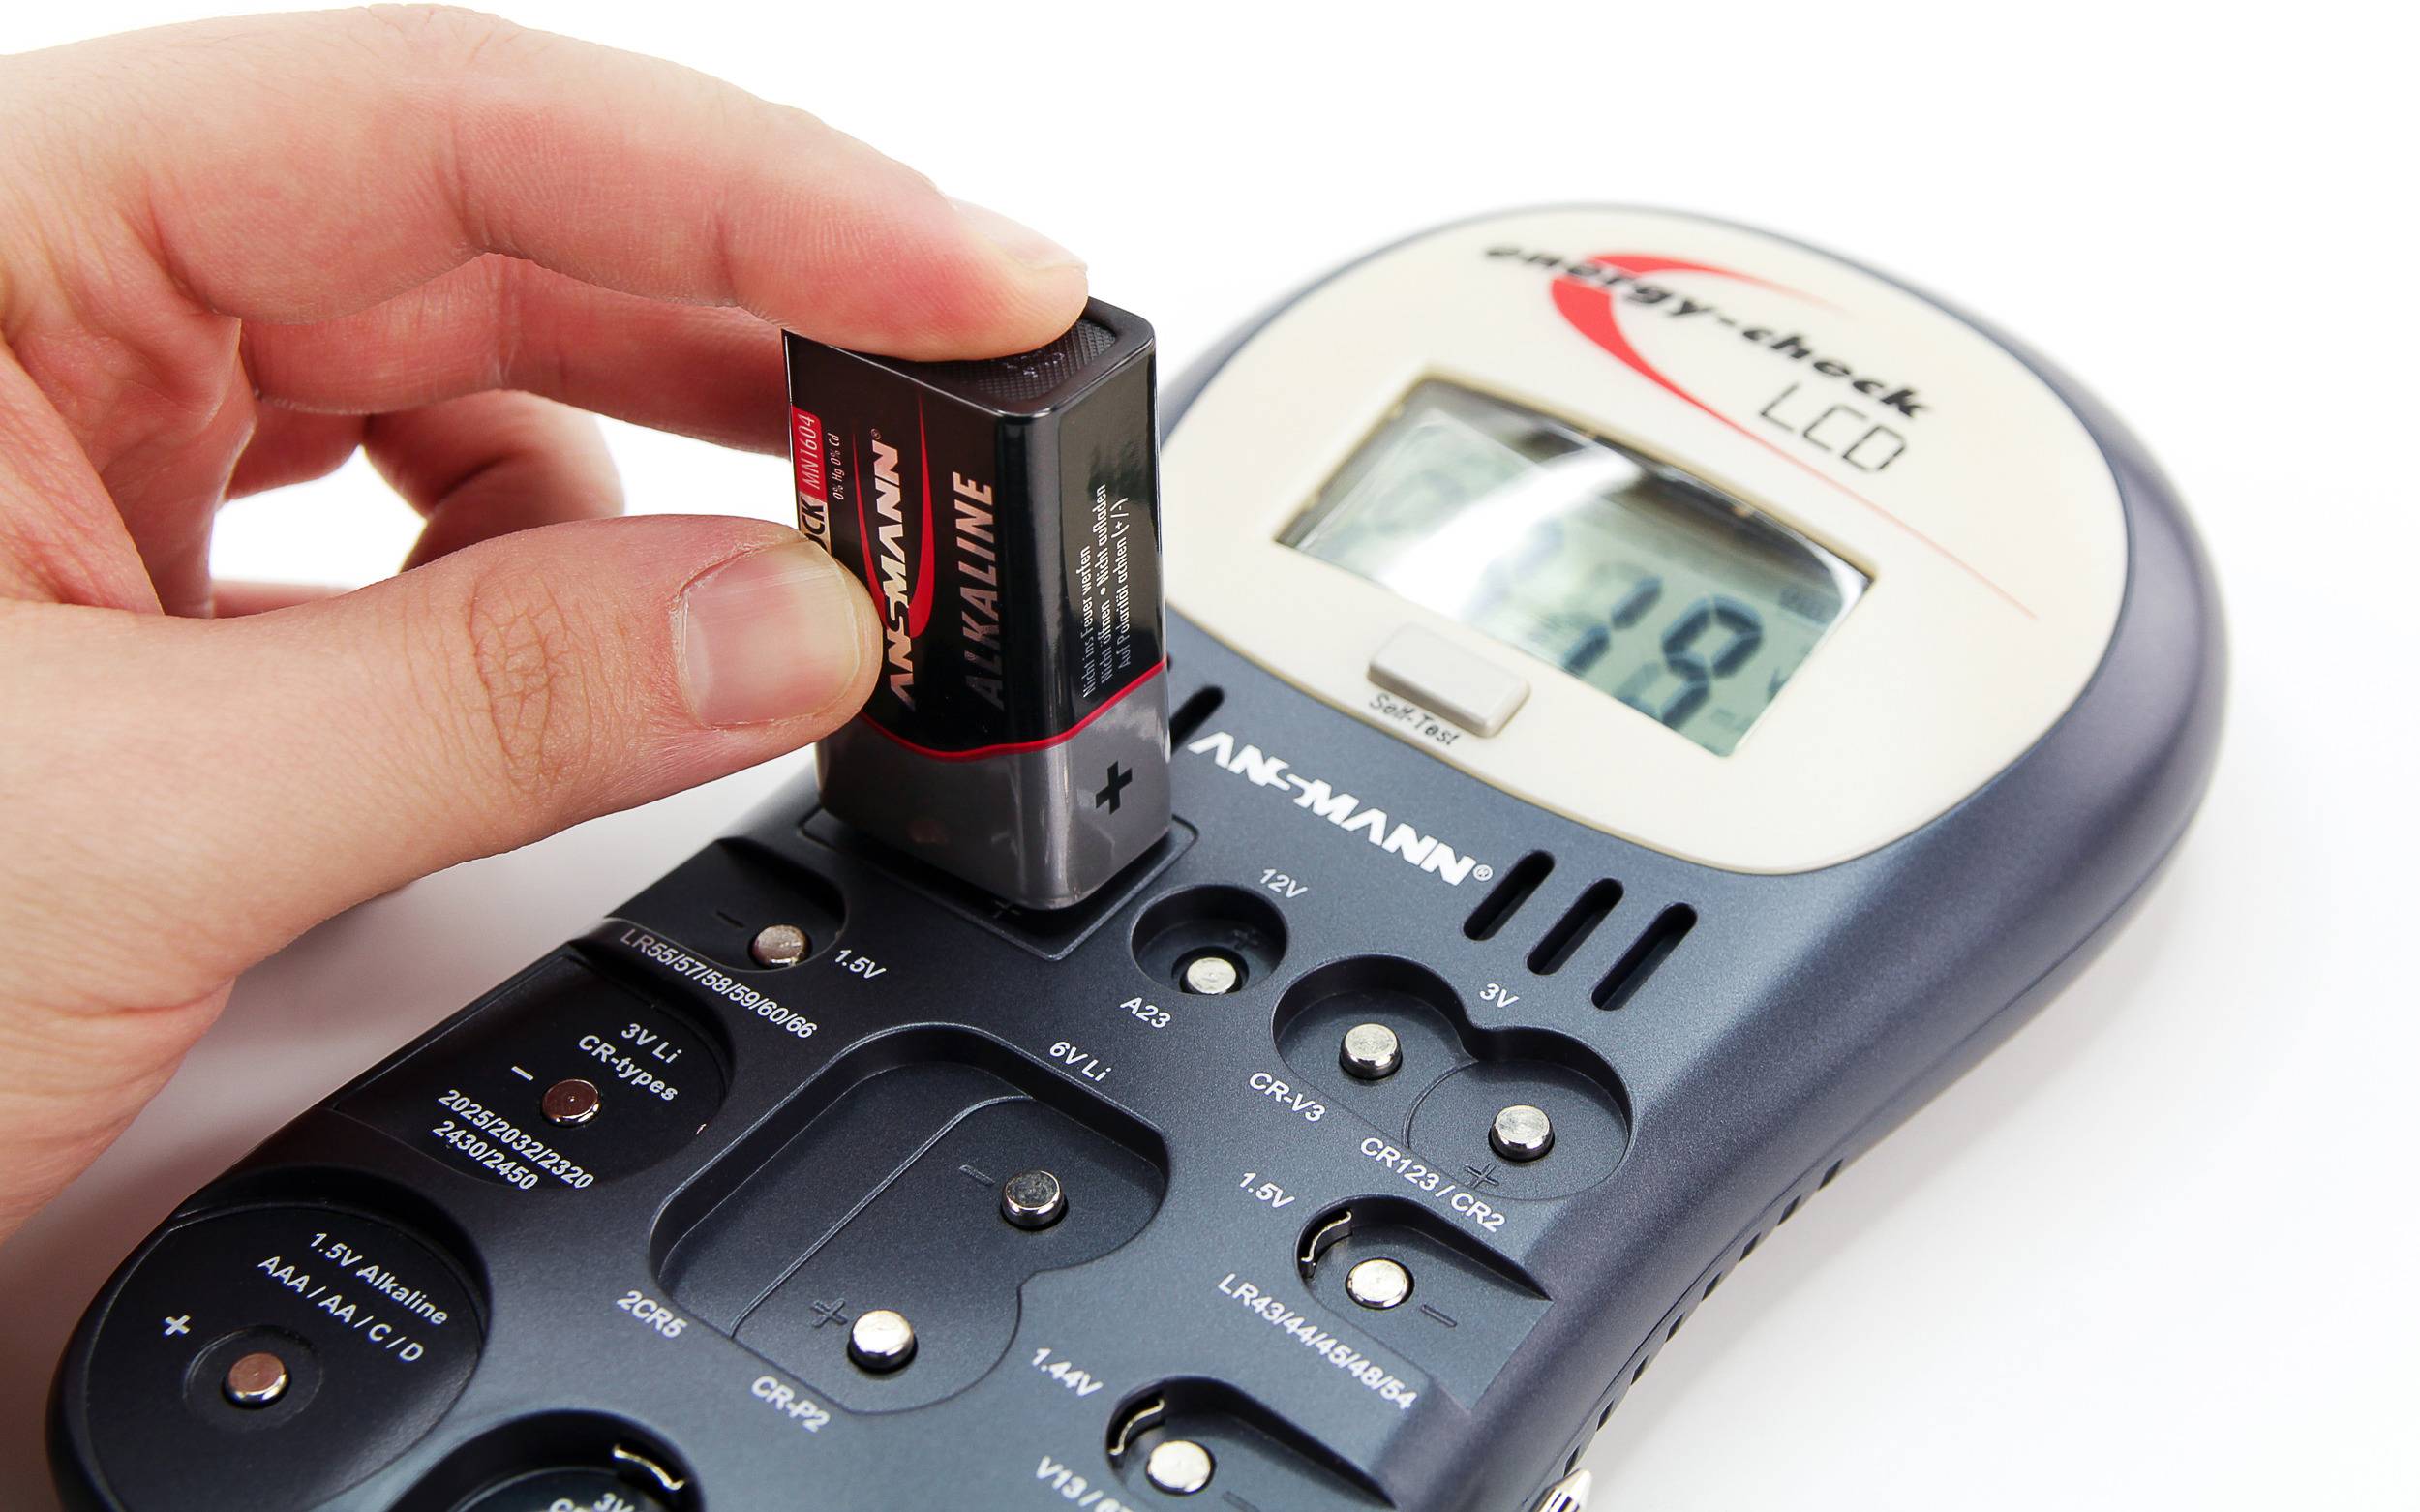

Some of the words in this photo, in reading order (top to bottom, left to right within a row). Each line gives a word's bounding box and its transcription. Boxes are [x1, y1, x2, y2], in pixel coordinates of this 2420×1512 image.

[1484, 246, 1934, 419] energy-check
[826, 432, 841, 447] Cd
[1759, 381, 1907, 473] LCD
[797, 413, 821, 491] MN1604
[832, 469, 846, 482] Hg
[1091, 484, 1108, 548] aufladen
[1075, 545, 1093, 596] werfen
[1094, 547, 1110, 588] Nicht
[1112, 536, 1129, 585] achten
[953, 470, 1007, 712] ALKALINE
[1079, 596, 1094, 639] Feuer
[1080, 636, 1095, 660] ins
[1099, 646, 1114, 684] Nicht
[1115, 644, 1132, 669] Auf
[1080, 659, 1097, 698] Nicht
[1259, 868, 1309, 899] 12V
[620, 927, 818, 1040] LR55/57/58/59/60/66
[834, 948, 888, 981] 1.5V
[1119, 996, 1171, 1029] A23
[1479, 983, 1520, 1009] 3V
[578, 1034, 679, 1102] CR-types
[620, 1023, 658, 1047] 3V
[651, 1042, 682, 1065] Li
[1048, 1041, 1089, 1066] 6V
[1081, 1058, 1112, 1082] Li
[1249, 1072, 1326, 1123] CR-V3
[432, 1120, 539, 1191] 2430/2450
[438, 1089, 595, 1190] 2025/2032/2320
[1239, 1170, 1295, 1209] 1.5V
[257, 1255, 311, 1294] AAA
[309, 1232, 364, 1268] 1.5V
[354, 1264, 449, 1326] Alkaline
[616, 1289, 687, 1340] 2CR5
[1216, 1271, 1420, 1411] LR43/44/45/48/54
[1030, 1346, 1104, 1398] 1.44V
[751, 1375, 832, 1434] CR-P2
